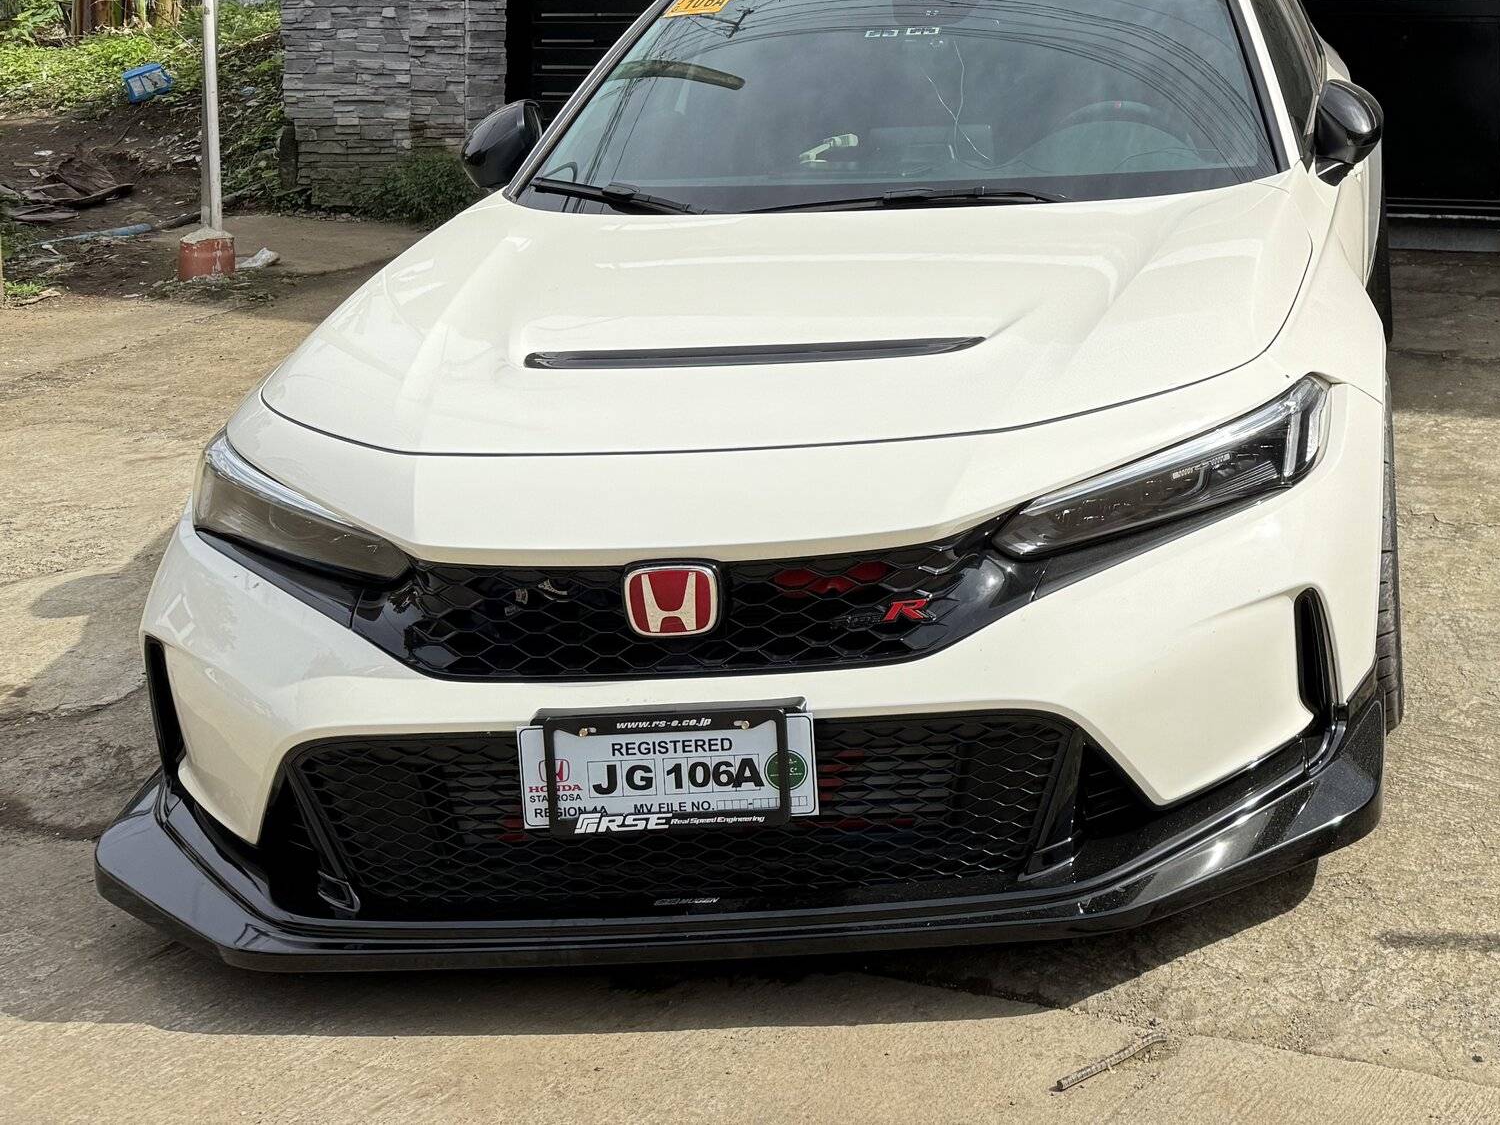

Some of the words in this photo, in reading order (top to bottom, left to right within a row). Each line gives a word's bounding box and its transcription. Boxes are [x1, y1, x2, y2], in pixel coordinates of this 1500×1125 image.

[880, 598, 929, 623] R
[616, 717, 712, 729] www.rs-e.co.jp
[611, 737, 733, 757] REGISTERED
[592, 763, 654, 795] JG
[666, 757, 765, 790] 106A
[633, 803, 653, 814] MV
[658, 801, 687, 813] FILE
[691, 800, 715, 812] NO.
[597, 813, 673, 832] RSE
[689, 816, 717, 825] Speed
[717, 815, 765, 824] Engineering
